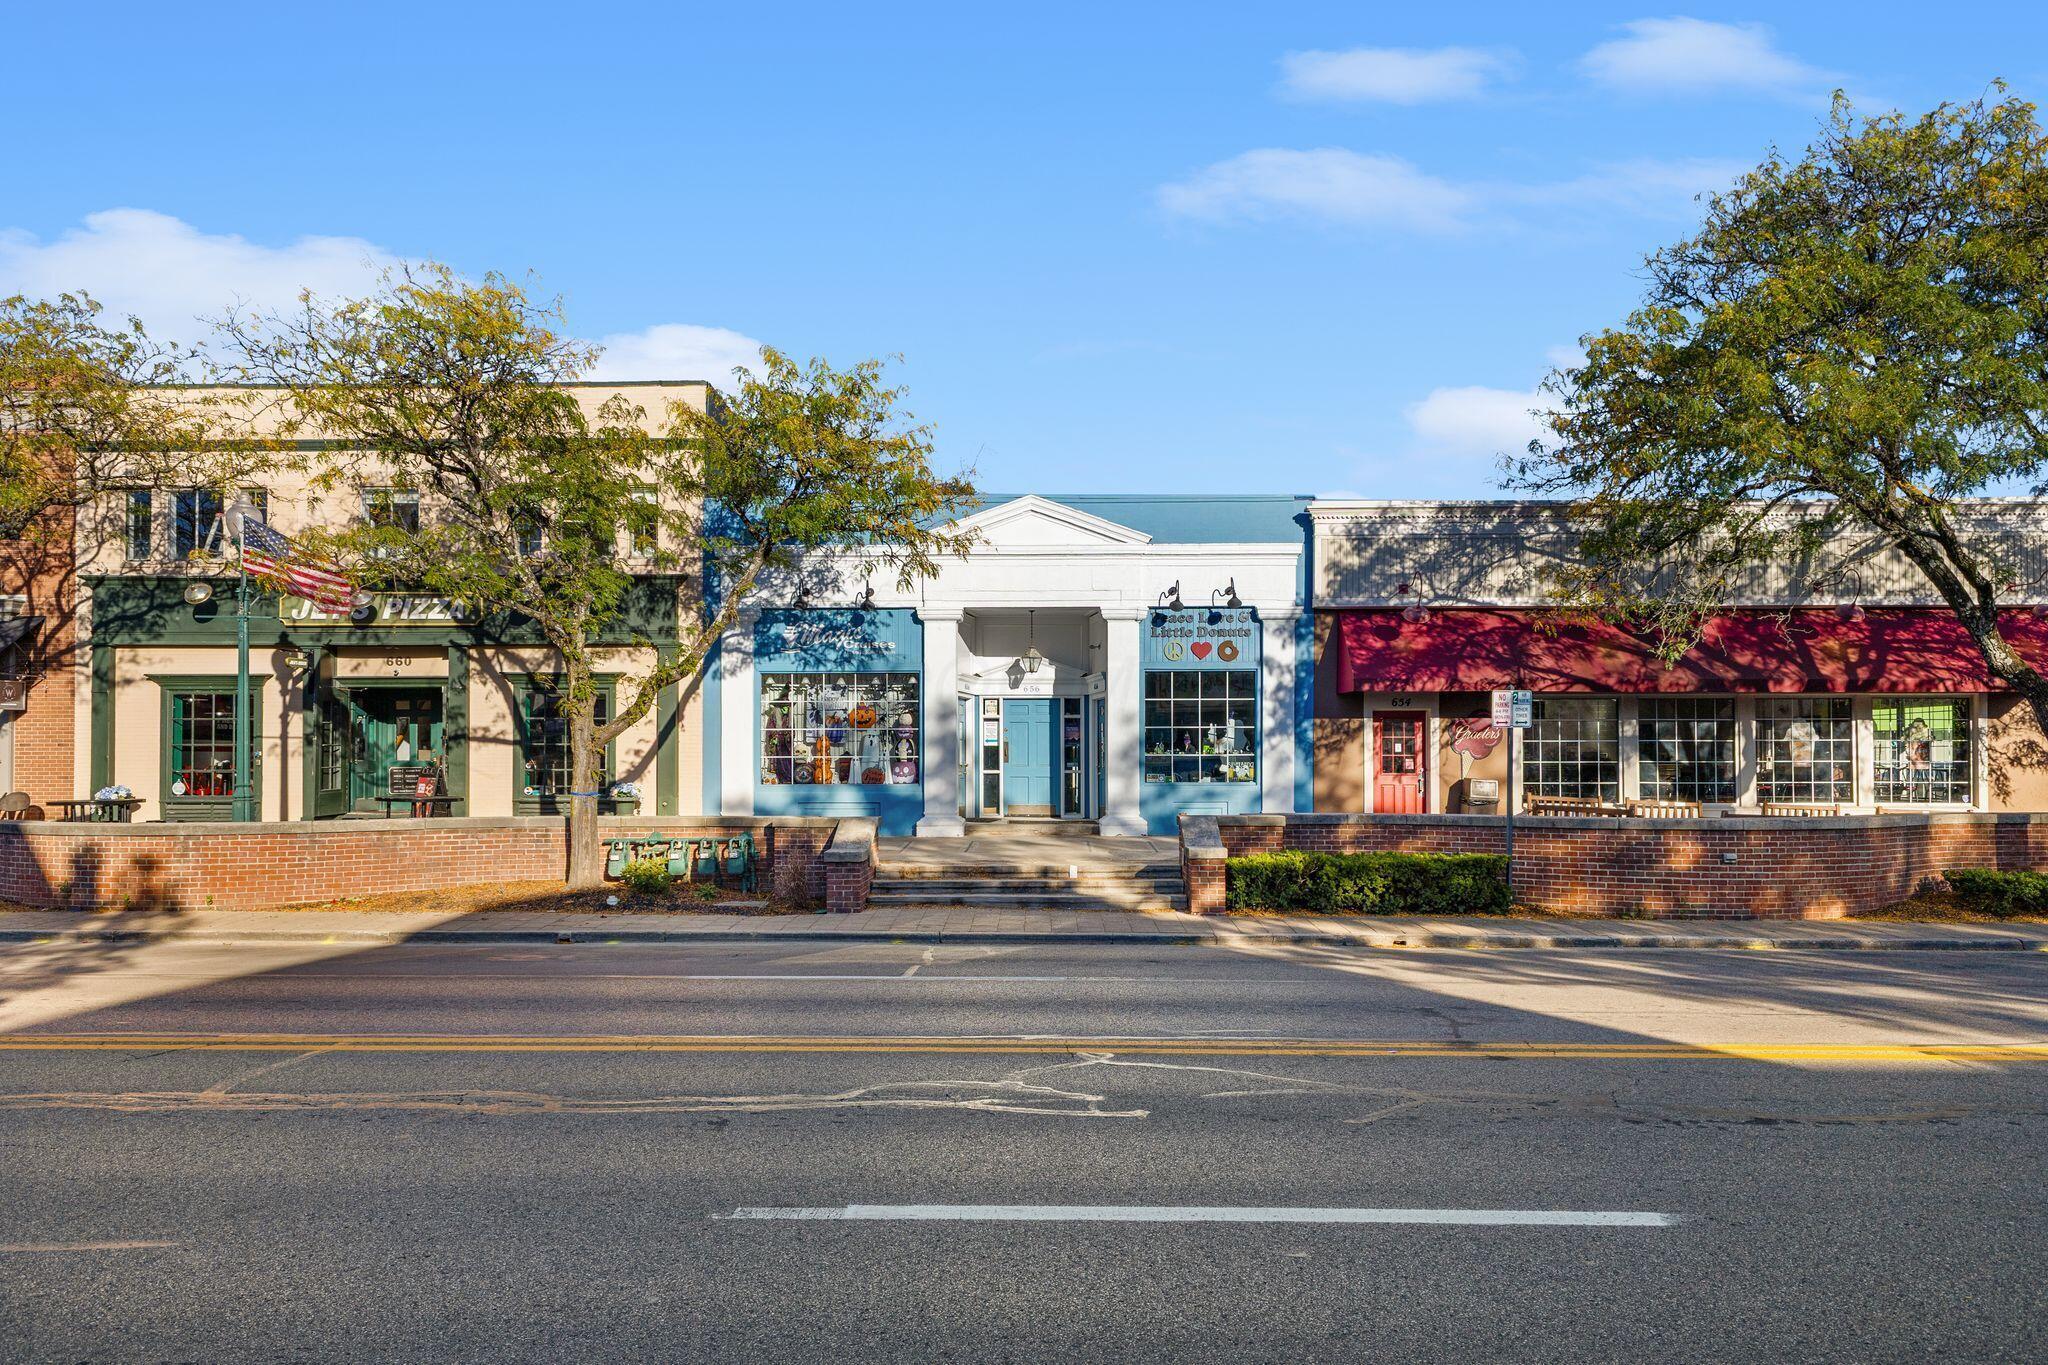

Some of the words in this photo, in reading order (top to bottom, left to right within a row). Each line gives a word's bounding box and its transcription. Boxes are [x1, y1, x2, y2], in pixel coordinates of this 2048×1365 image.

[382, 597, 464, 620] PIZZA
[1198, 611, 1234, 624] Lve
[795, 621, 867, 650] Magic
[1151, 626, 1194, 638] Little
[1196, 626, 1252, 638] Donuts
[843, 640, 897, 649] Cruises
[386, 656, 412, 667] 660
[1023, 685, 1040, 693] 656
[1391, 697, 1412, 707] 654
[1498, 693, 1507, 701] NO
[1455, 725, 1500, 745] Graeter's
